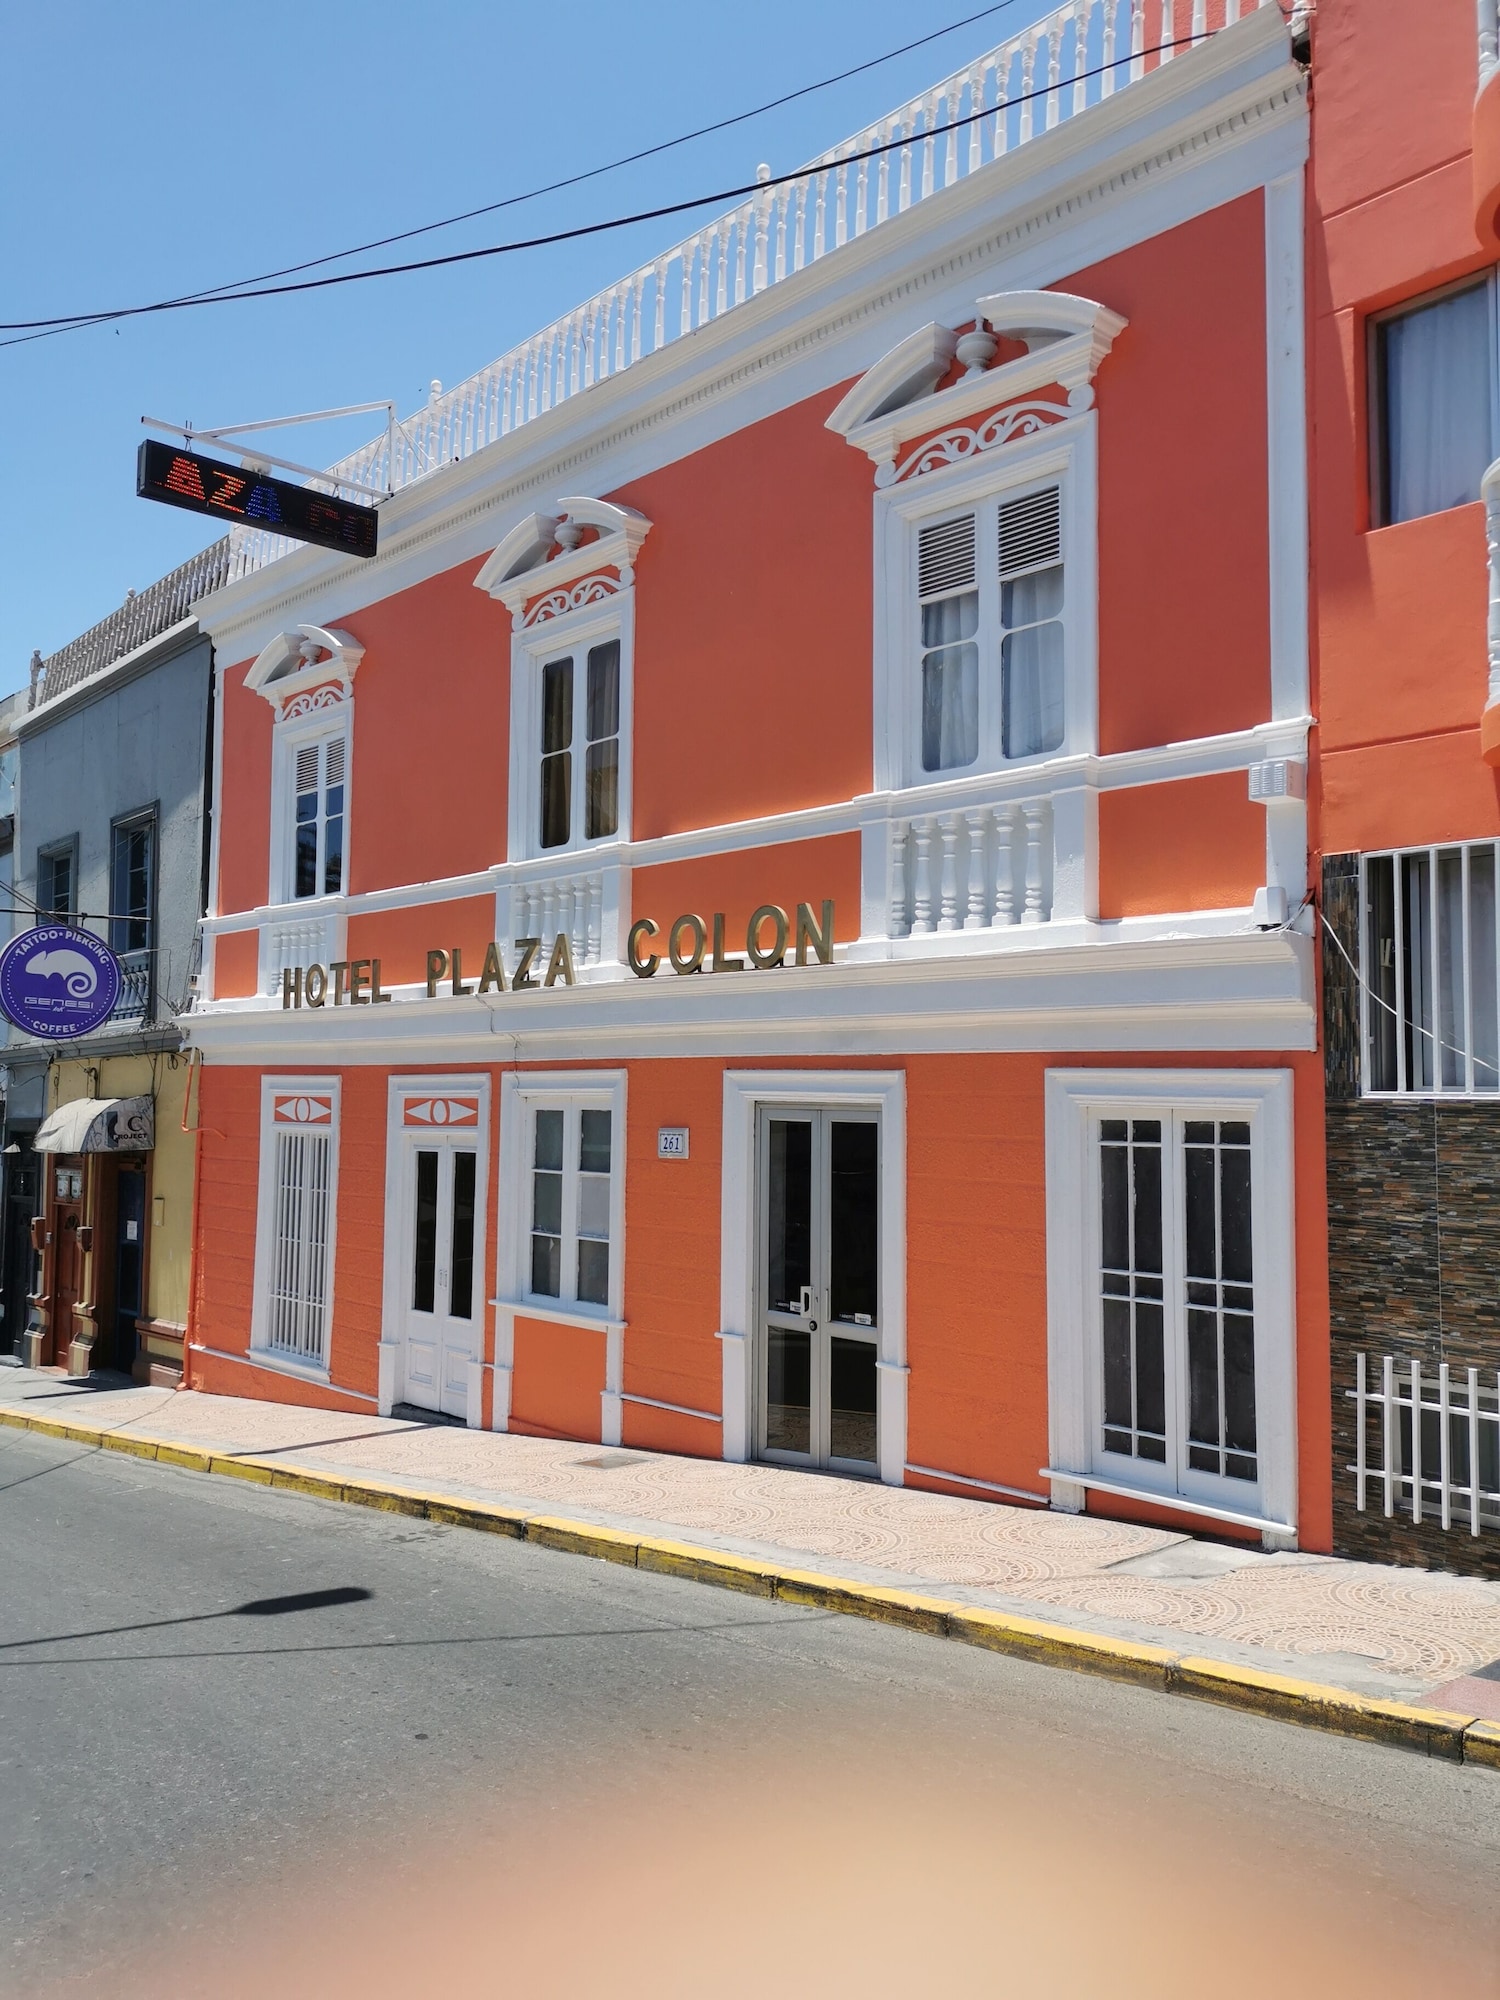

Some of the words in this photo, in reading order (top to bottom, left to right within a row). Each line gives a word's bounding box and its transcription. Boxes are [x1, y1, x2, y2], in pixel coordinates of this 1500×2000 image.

[16, 930, 59, 957] TATTOO
[65, 930, 110, 965] PIERCING
[283, 958, 392, 1010] HOTEL
[427, 933, 576, 998] PLAZA
[627, 899, 835, 979] COLON
[33, 1020, 77, 1033] COFFEE
[663, 1136, 679, 1150] 261
